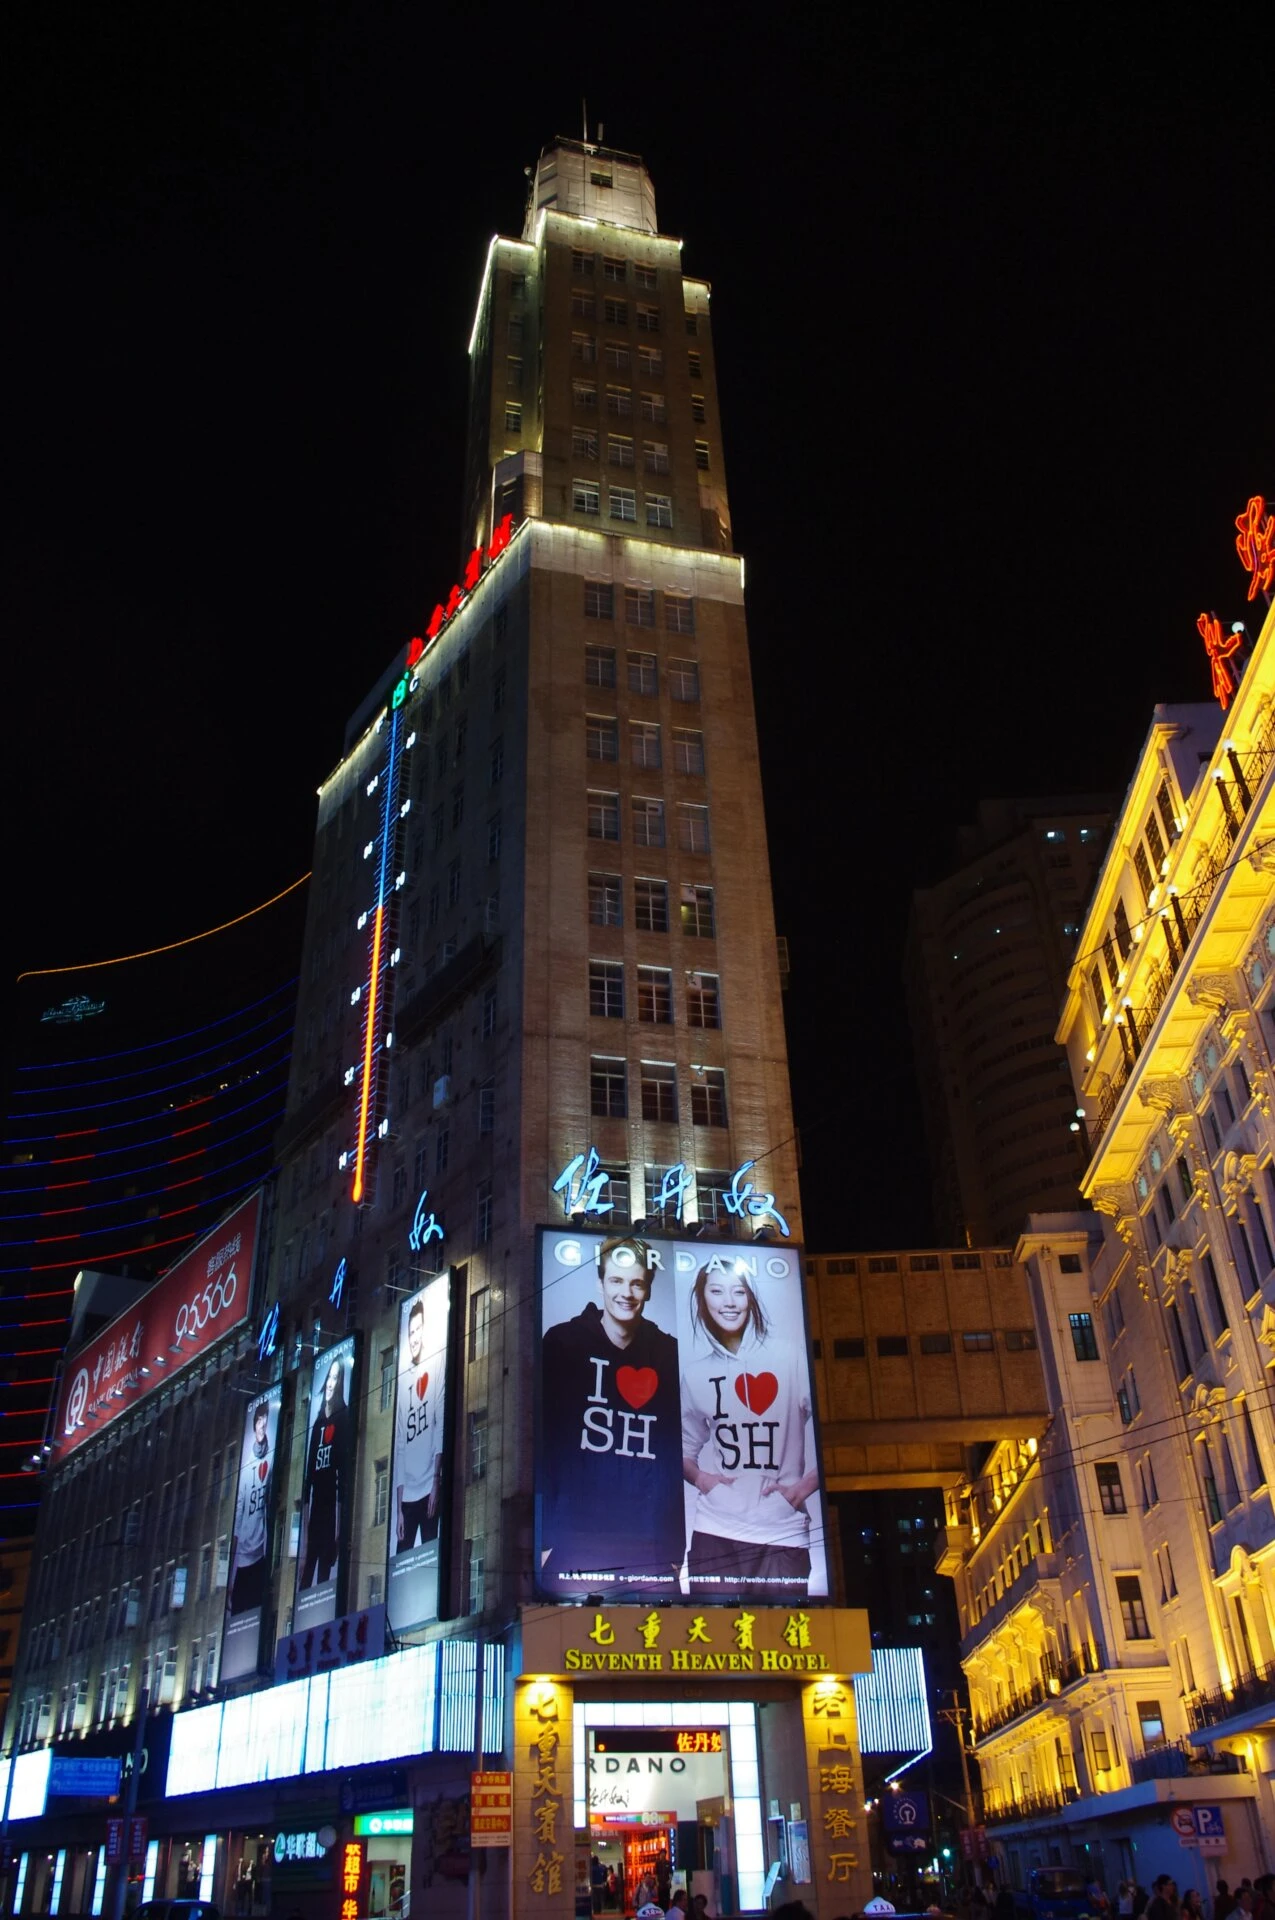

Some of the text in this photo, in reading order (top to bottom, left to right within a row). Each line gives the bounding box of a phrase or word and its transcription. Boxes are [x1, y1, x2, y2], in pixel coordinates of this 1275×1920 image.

[552, 1146, 789, 1237] 佐丹奴
[554, 1240, 789, 1279] GIORDANO
[176, 1262, 236, 1347] 95566
[93, 1320, 144, 1393] 中国银行
[315, 1338, 354, 1370] GIORDANO
[587, 1357, 609, 1404] I
[709, 1376, 729, 1420] I
[407, 1401, 428, 1444] SH
[580, 1406, 657, 1460] SH
[315, 1446, 332, 1470] SH
[715, 1421, 780, 1470] SH
[565, 1649, 829, 1671] SEVENTH HEAVEN HOTEL
[1197, 1809, 1212, 1834] P
